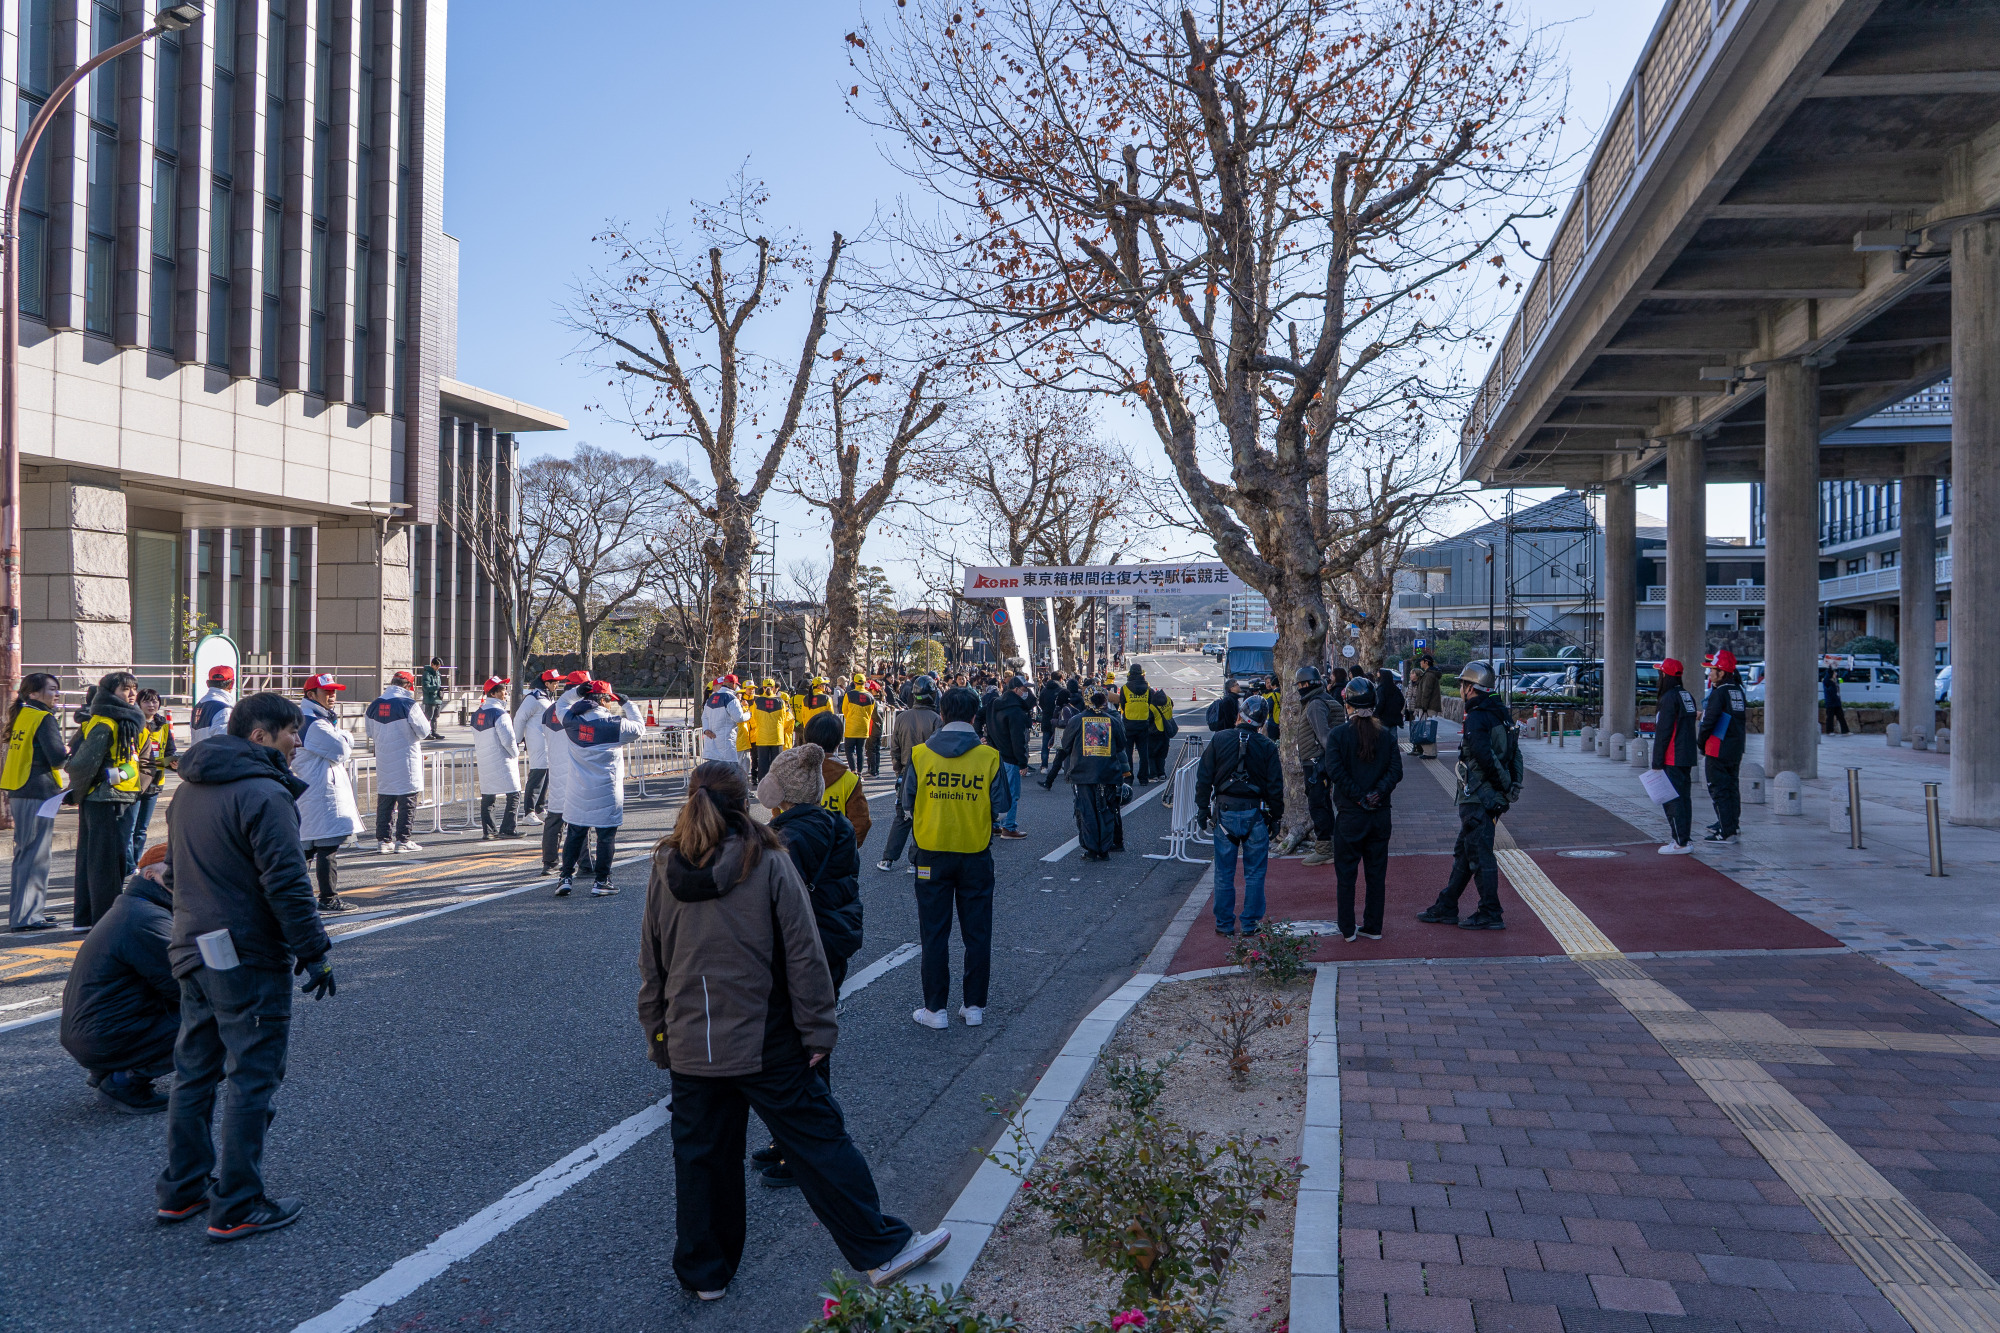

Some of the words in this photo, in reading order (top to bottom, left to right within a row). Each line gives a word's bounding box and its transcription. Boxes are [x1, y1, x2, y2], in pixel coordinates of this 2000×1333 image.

[1022, 568, 1229, 586] 東京箱根間往復大学駅伝競走
[926, 772, 984, 790] 大日テレビ
[930, 790, 964, 800] dainichi
[966, 792, 978, 801] TV
